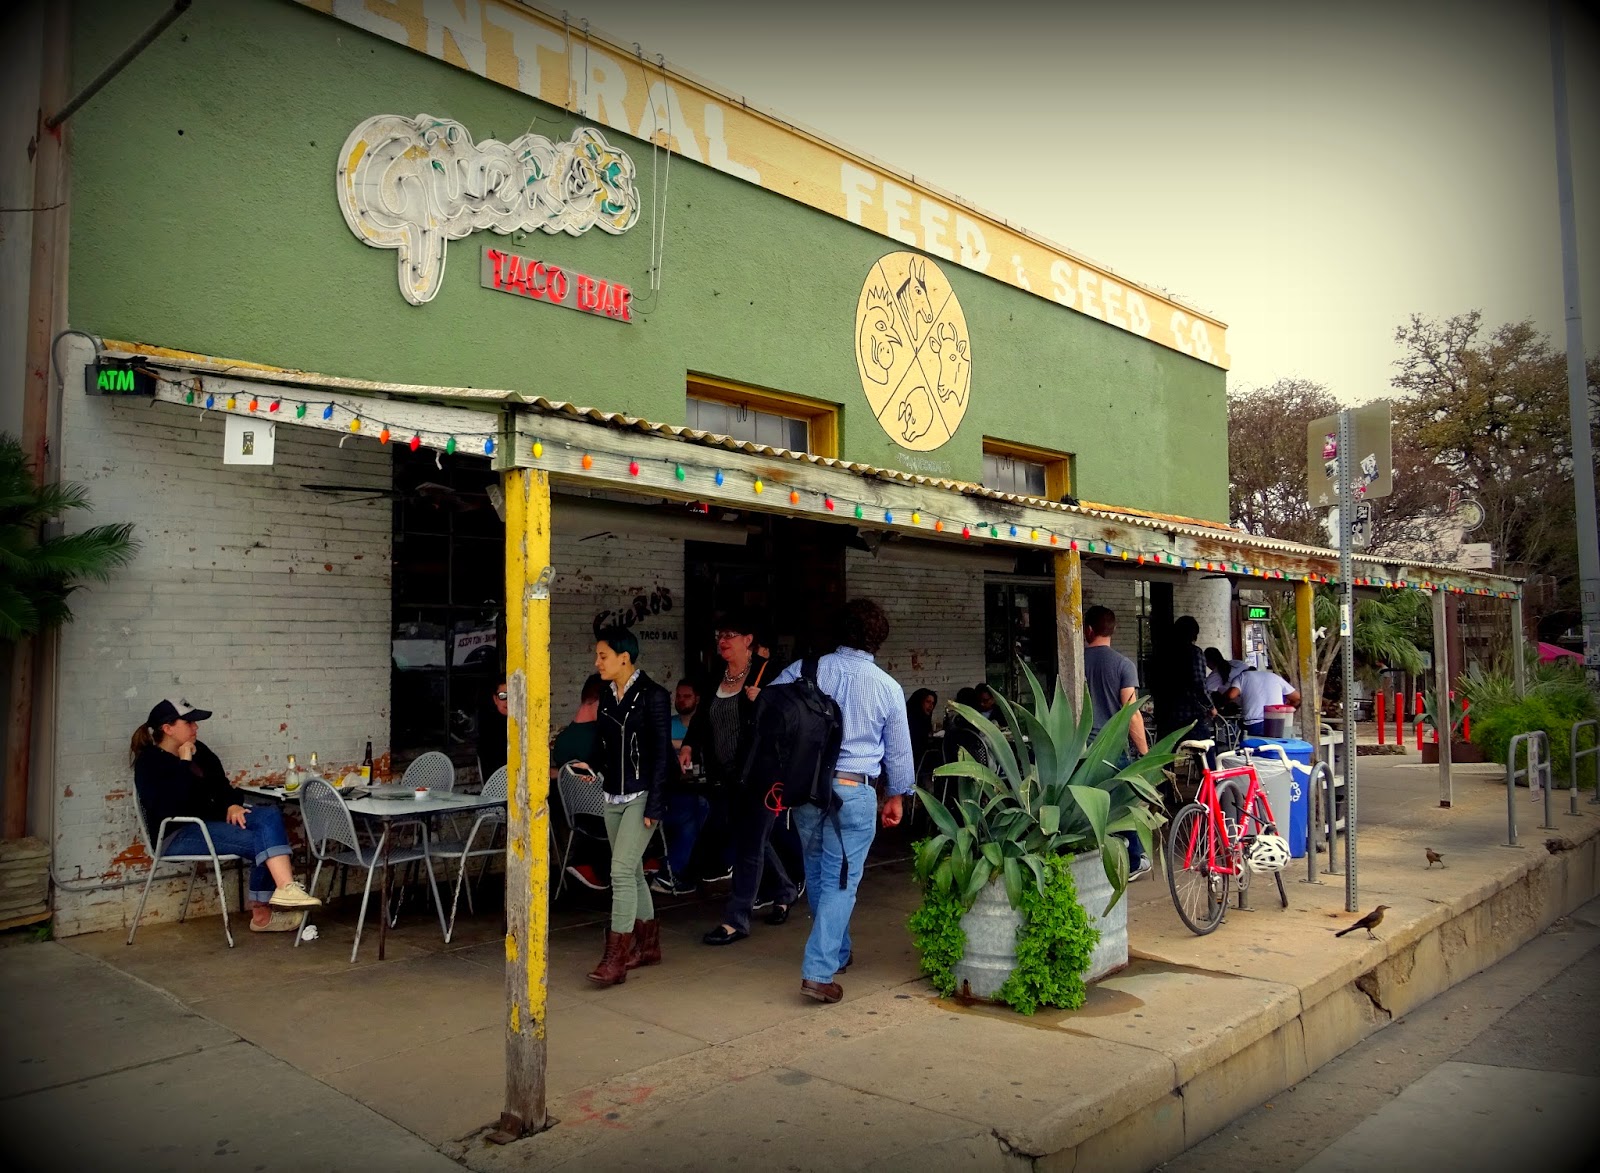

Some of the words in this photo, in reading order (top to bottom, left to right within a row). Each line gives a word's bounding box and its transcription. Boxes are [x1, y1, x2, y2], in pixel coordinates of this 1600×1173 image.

[293, 0, 761, 185] ENTRAL
[840, 162, 991, 273] FEED
[1050, 259, 1151, 338] SEED
[488, 249, 570, 303] TACO
[577, 274, 634, 320] BAR
[97, 370, 134, 391] ATM
[640, 631, 659, 640] TACO
[662, 631, 679, 640] BAR
